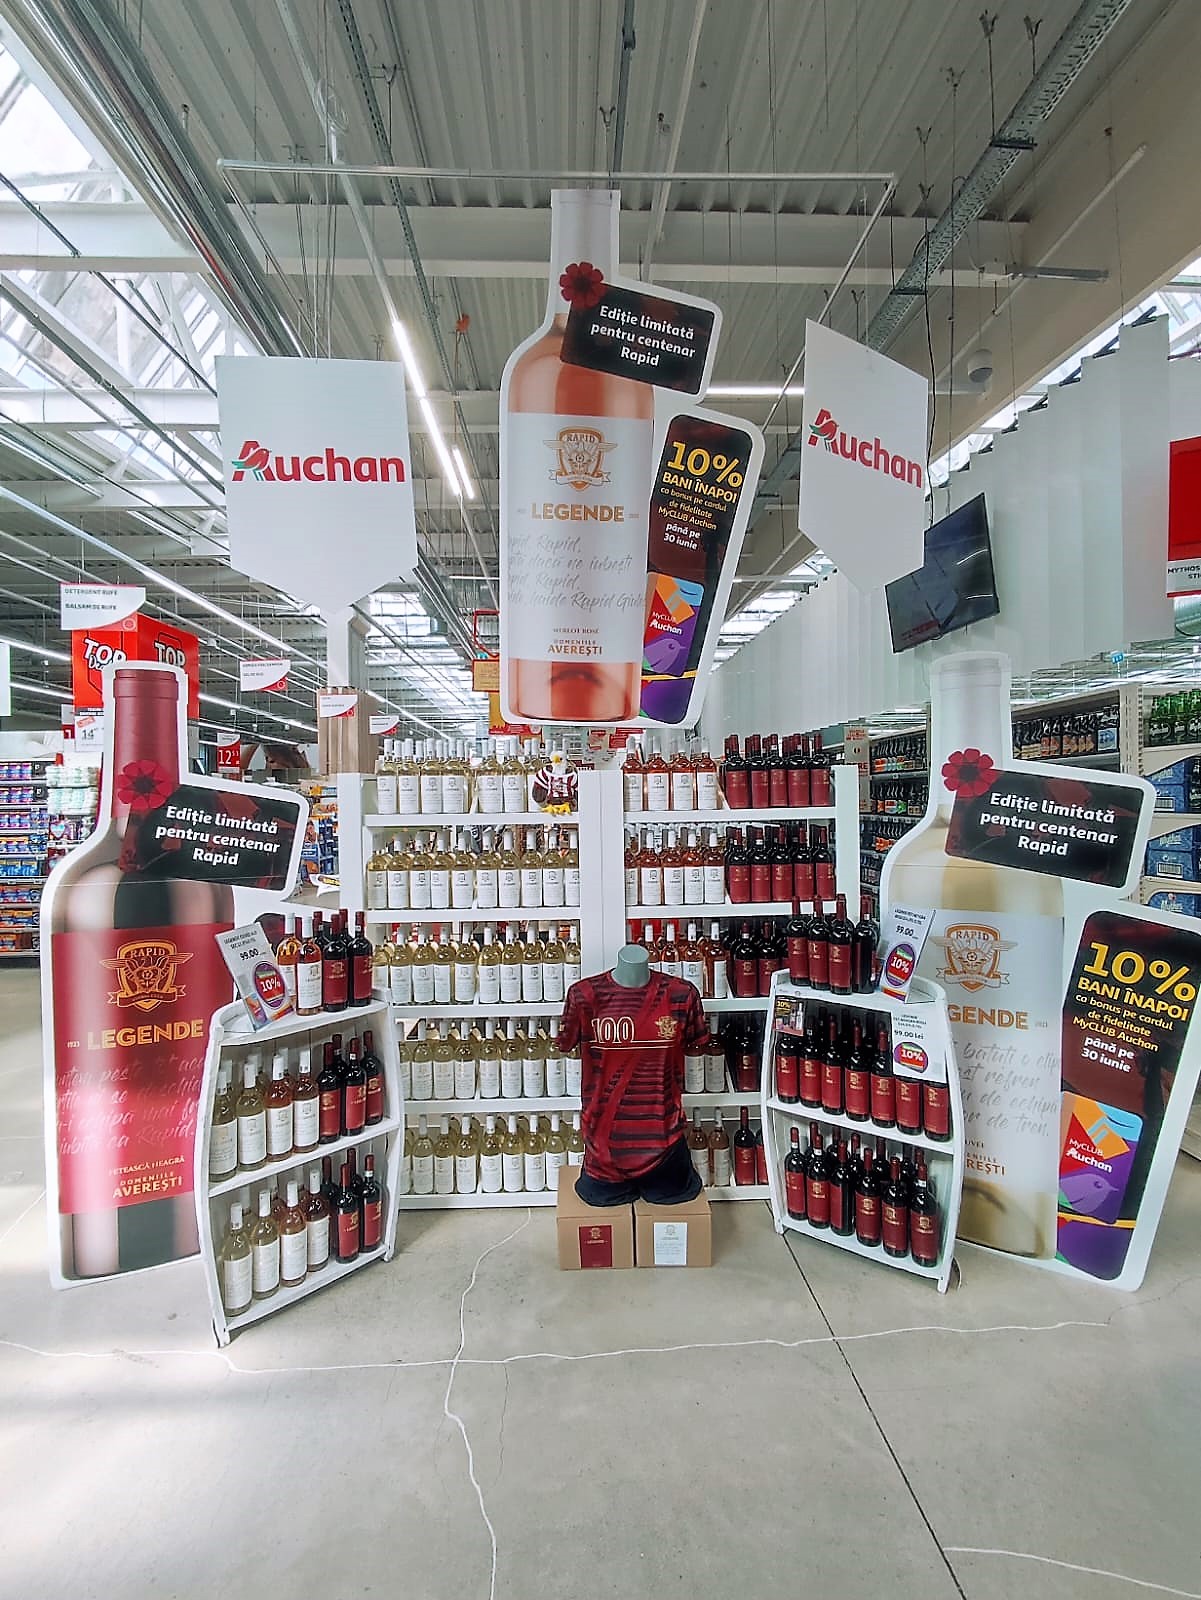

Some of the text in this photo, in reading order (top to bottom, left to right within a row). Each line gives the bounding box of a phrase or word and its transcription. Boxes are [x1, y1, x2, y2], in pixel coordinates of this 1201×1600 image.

[599, 305, 694, 340] Ediție limitată
[590, 323, 696, 358] pentru centenar
[620, 345, 660, 366] Rapid
[566, 432, 596, 444] RAPID
[808, 408, 922, 488] Auchan
[231, 440, 405, 483] Auchan
[667, 441, 743, 488] 10%
[662, 471, 738, 503] BANI ÎNAPOI
[668, 500, 713, 519] de fidelitate
[670, 488, 693, 501] bonus
[693, 497, 703, 505] pe
[704, 500, 727, 512] cardul
[531, 503, 625, 522] LEGENDE
[658, 506, 689, 521] MyCLUB
[689, 516, 717, 530] Auchan
[663, 532, 698, 550] 30 iunie
[665, 523, 701, 540] până pe
[649, 619, 682, 635] Auchan
[83, 638, 128, 664] TOP
[154, 641, 186, 668] TOP
[165, 805, 278, 835] Ediție limitată
[989, 792, 1115, 824] Ediție limitată
[155, 825, 280, 853] pentru centenar
[980, 812, 1118, 845] pentru centenar
[192, 847, 240, 866] Rapid
[1017, 835, 1069, 856] Rapid
[895, 924, 914, 937] 99.00
[955, 930, 990, 942] RAPID
[130, 947, 166, 959] RAPID
[239, 948, 259, 961] 99.00
[890, 956, 909, 974] 10%
[260, 976, 281, 992] 10%
[1083, 942, 1196, 1002] 10%
[1077, 976, 1190, 1022] BANI ÎNAPOI
[948, 1004, 1029, 1030] GENDE
[1087, 1010, 1152, 1037] de fidelitate
[1089, 996, 1121, 1014] bonus
[1122, 1008, 1137, 1020] pe
[1139, 1012, 1174, 1031] cardul
[87, 1019, 205, 1050] LEGENDE
[591, 1016, 635, 1043] 100
[1072, 1016, 1116, 1038] MyCLUB
[1116, 1031, 1159, 1052] Auchan
[901, 1049, 924, 1062] 10%
[1081, 1047, 1132, 1073] 30 iunie
[1084, 1037, 1135, 1060] până pe
[1069, 1138, 1103, 1156] MyCLUB
[966, 1158, 1005, 1176] REȘTI
[1065, 1147, 1113, 1173] Auchan
[112, 1175, 183, 1199] AVEREȘTI
[119, 1171, 174, 1186] DOMENIILE
